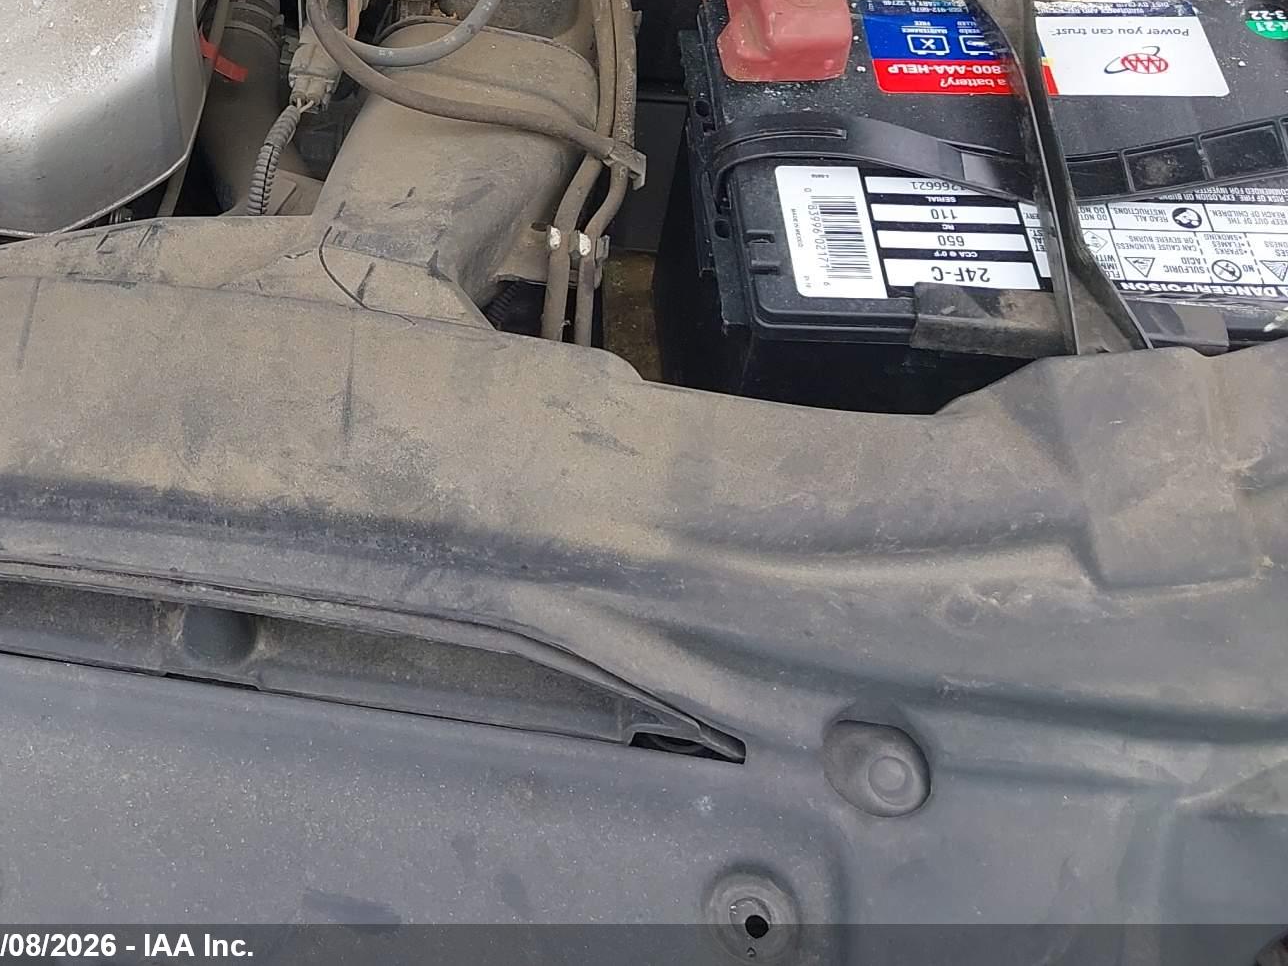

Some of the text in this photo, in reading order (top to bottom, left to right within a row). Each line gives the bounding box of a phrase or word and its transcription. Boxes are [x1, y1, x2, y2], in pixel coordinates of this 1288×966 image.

[1118, 26, 1142, 35] you
[1148, 28, 1189, 37] Power
[887, 64, 1001, 74] 800-AAA-HELP
[1121, 55, 1162, 74] AAA
[939, 76, 1008, 88] a battery?
[910, 181, 964, 191] 266621
[930, 208, 958, 220] 110
[1261, 211, 1286, 219] REACH
[1133, 215, 1169, 223] READ ALL
[1243, 217, 1252, 225] OF
[1254, 217, 1269, 225] OUT
[937, 235, 965, 247] 650
[1203, 233, 1239, 241] SMOKING
[1115, 242, 1197, 252] CAN CAUSE BLINDNESS
[1211, 240, 1240, 248] FLAMES
[815, 238, 830, 268] 02171
[1214, 247, 1245, 255] SPARKS
[1181, 257, 1201, 265] ACID
[1163, 265, 1205, 274] SULFURIC
[1242, 264, 1255, 273] NO
[930, 266, 991, 283] 24F-C
[1120, 282, 1278, 297] DANGER/POISON
